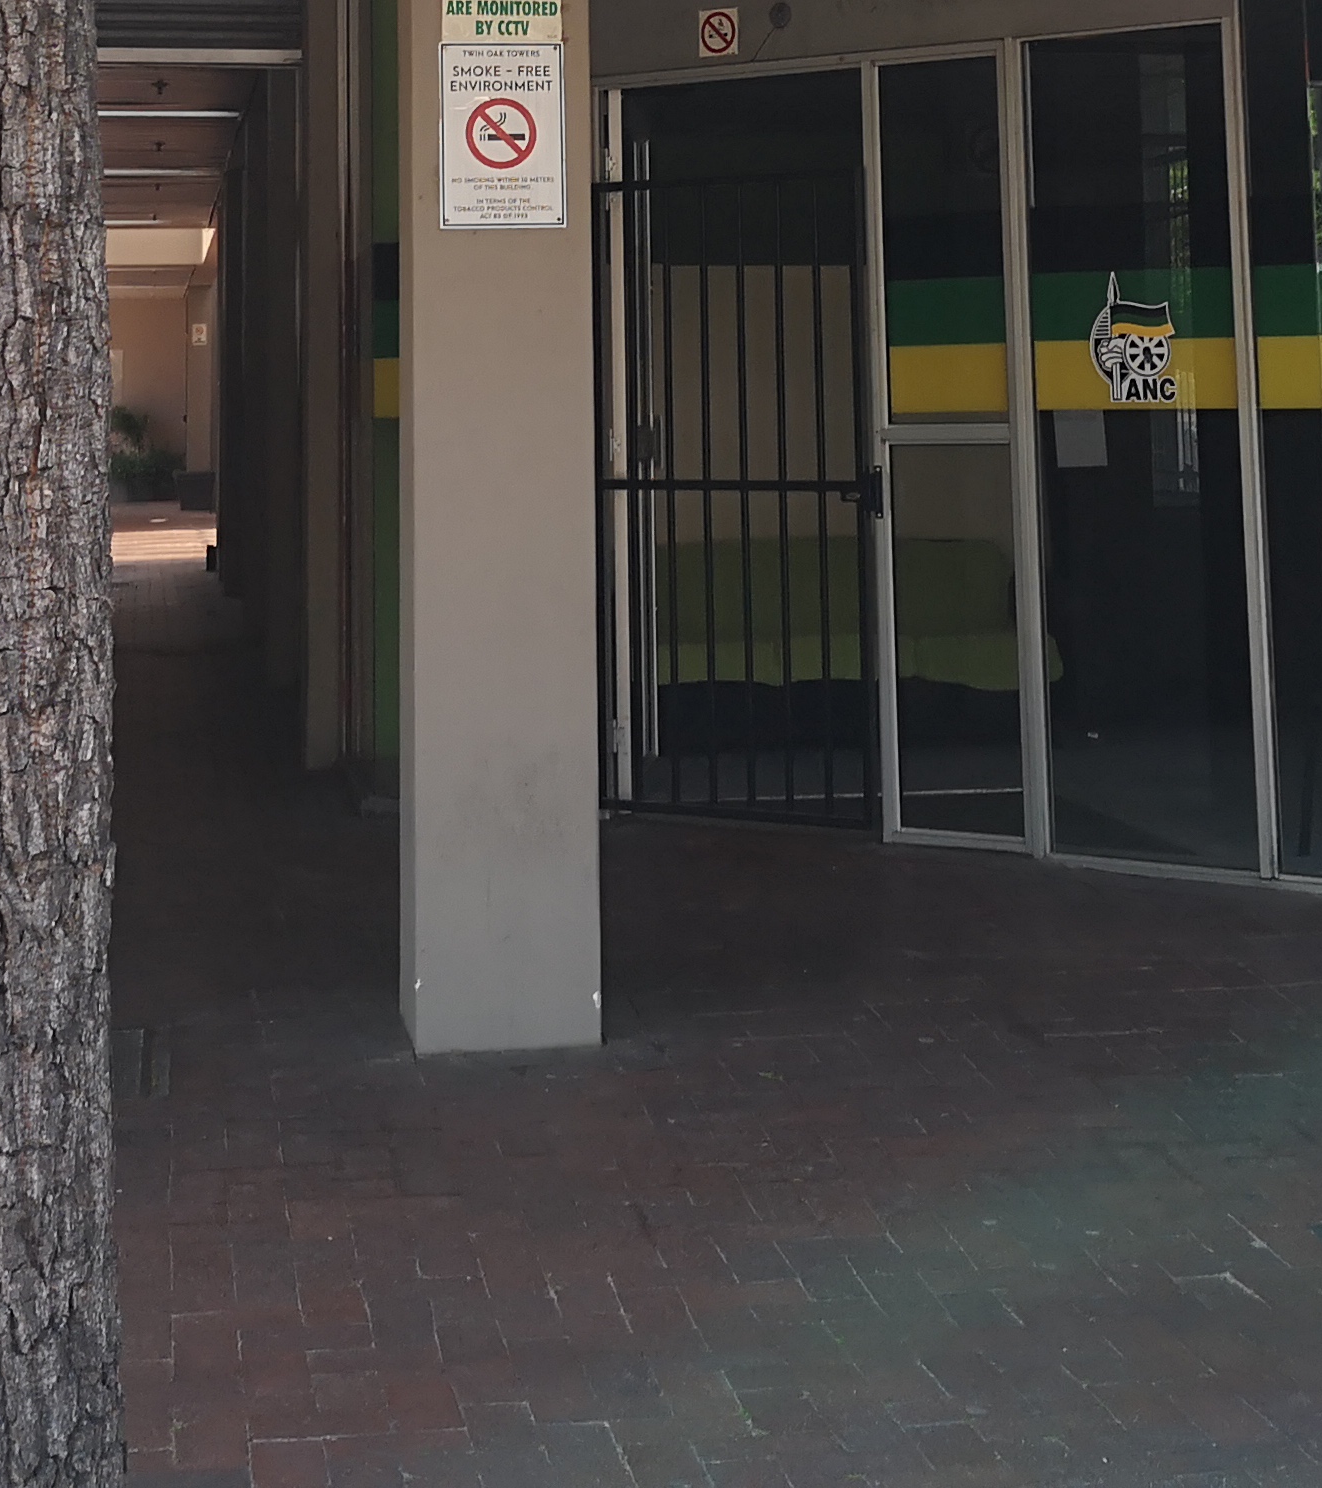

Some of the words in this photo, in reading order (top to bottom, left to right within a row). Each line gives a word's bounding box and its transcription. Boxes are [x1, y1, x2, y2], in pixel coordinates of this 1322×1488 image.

[446, 0, 473, 16] ARE
[477, 0, 558, 17] MONITORED
[475, 20, 495, 36] BY
[497, 20, 530, 36] CCTV
[462, 50, 484, 58] TWIN
[486, 50, 504, 58] OAK
[506, 50, 541, 58] TOWERS
[452, 65, 501, 77] SMOKE
[517, 65, 551, 77] FREE
[450, 80, 553, 92] ENVIRONMENT
[1125, 378, 1176, 401] ANC
